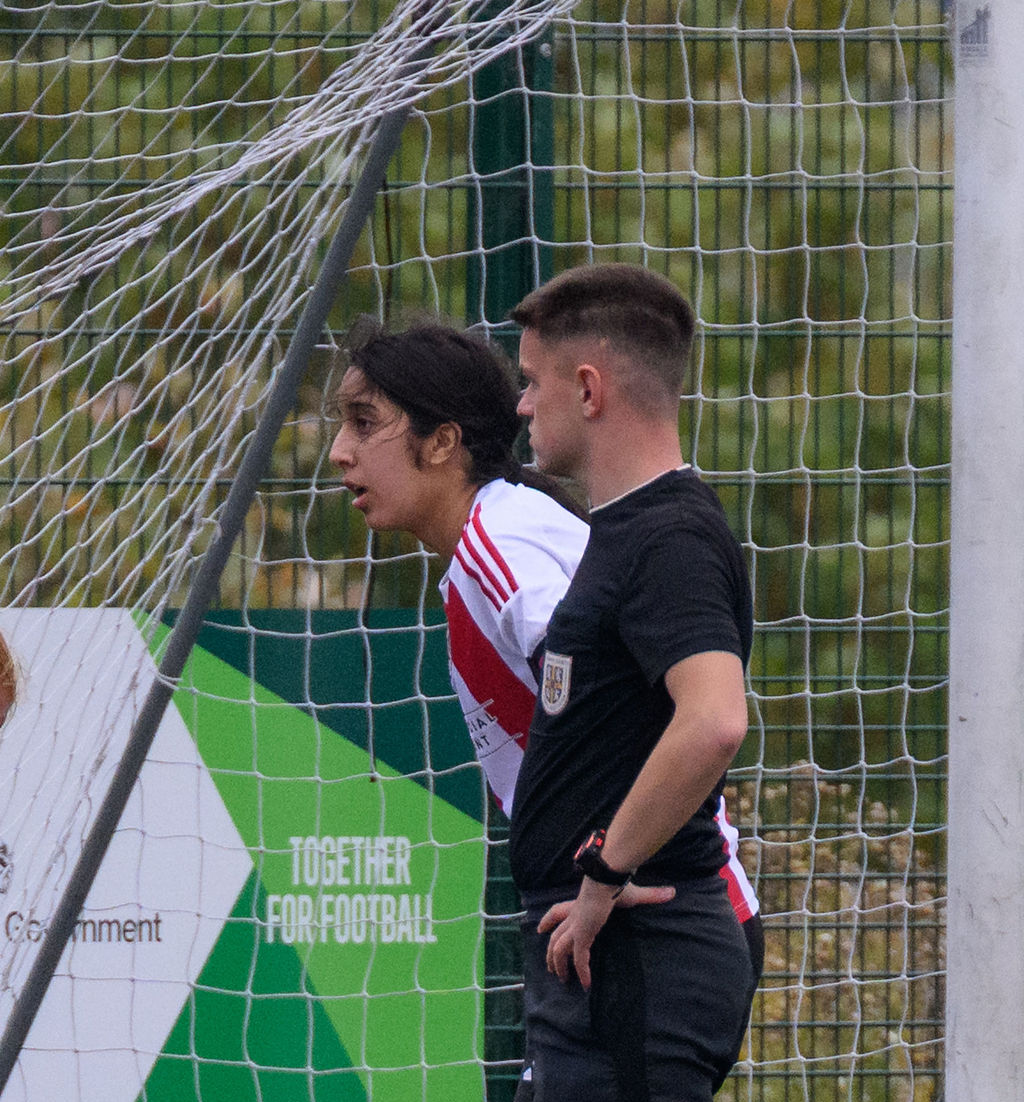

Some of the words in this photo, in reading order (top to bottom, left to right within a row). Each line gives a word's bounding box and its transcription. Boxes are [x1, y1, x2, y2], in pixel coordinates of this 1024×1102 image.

[289, 836, 412, 886] TOGETHER
[5, 911, 162, 943] Gonment
[266, 893, 314, 944] FOR
[320, 893, 438, 944] FOOTBALL
